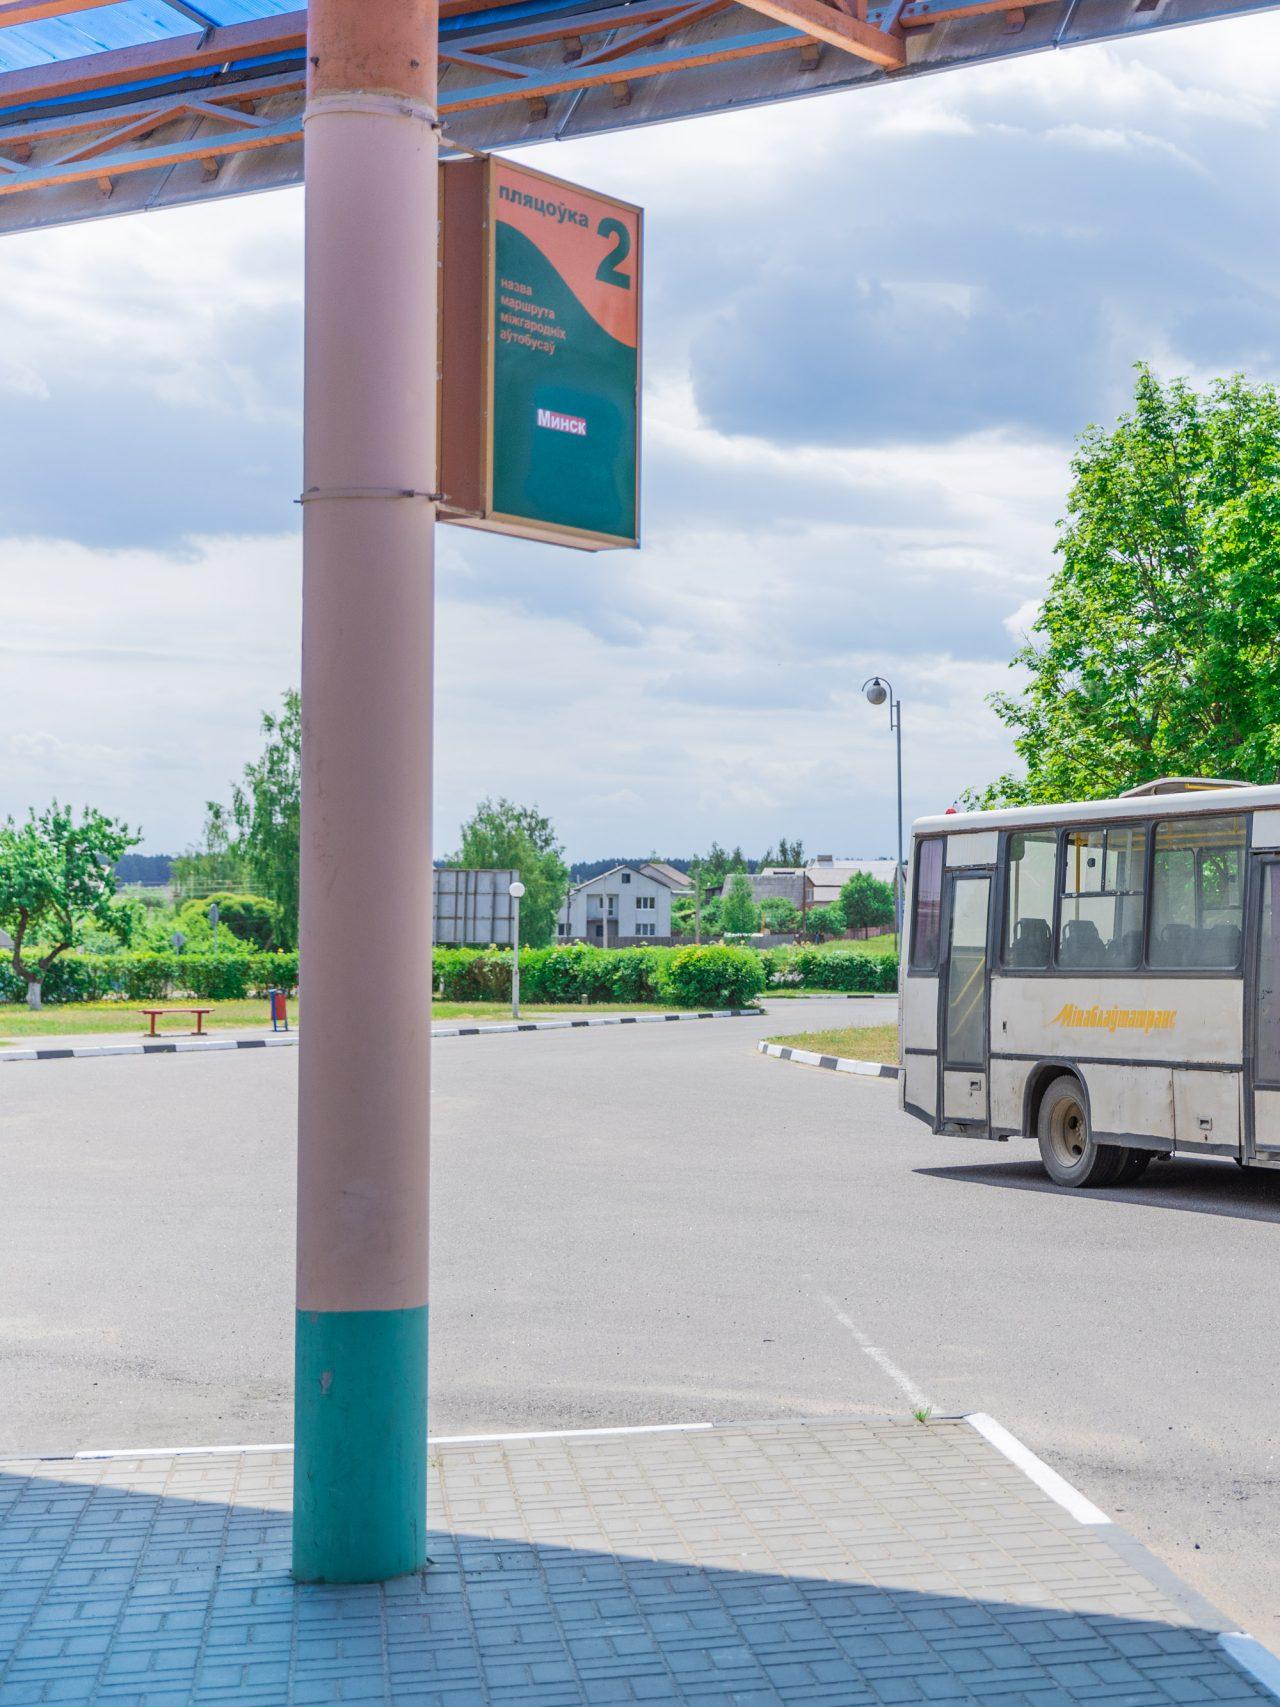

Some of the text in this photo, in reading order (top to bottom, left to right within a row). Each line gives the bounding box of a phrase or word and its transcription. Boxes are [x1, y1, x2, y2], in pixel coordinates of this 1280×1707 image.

[499, 185, 630, 290] пляцоўка 2
[501, 279, 532, 296] назва
[501, 295, 554, 320] маршрута
[501, 312, 566, 340] міжгародніх
[500, 329, 554, 355] аўтобусаў
[537, 408, 586, 436] Минск
